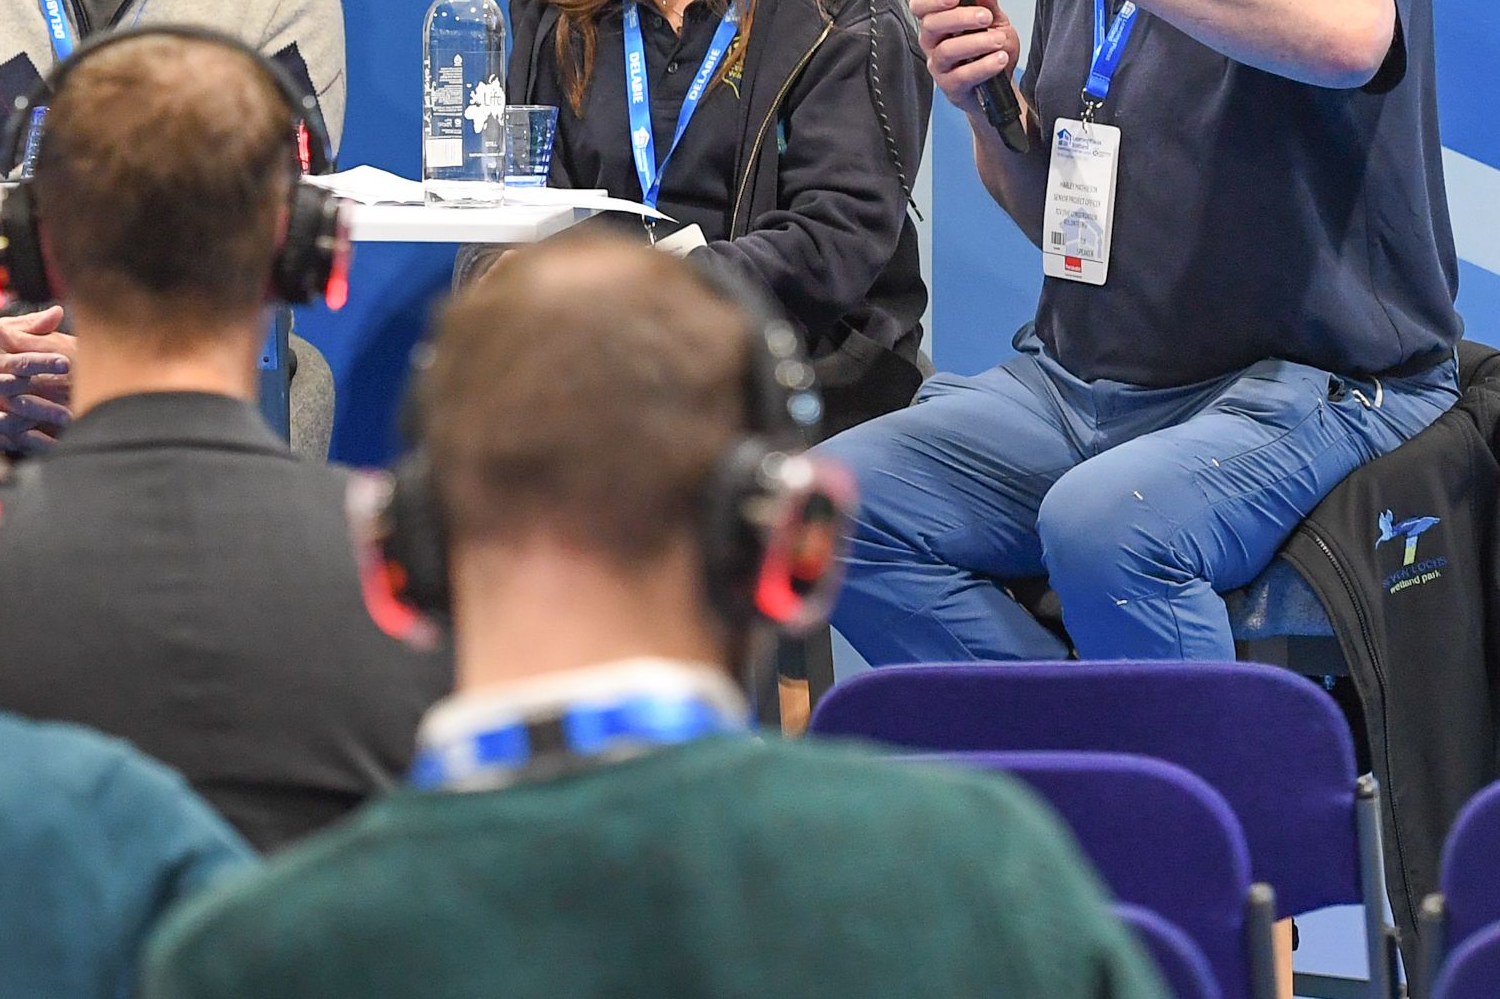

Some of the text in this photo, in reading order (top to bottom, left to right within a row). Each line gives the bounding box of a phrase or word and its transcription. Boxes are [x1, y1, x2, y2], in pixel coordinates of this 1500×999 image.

[629, 51, 644, 104] DELABIE
[689, 48, 721, 101] DELABIE
[1390, 570, 1442, 594] wetland park
